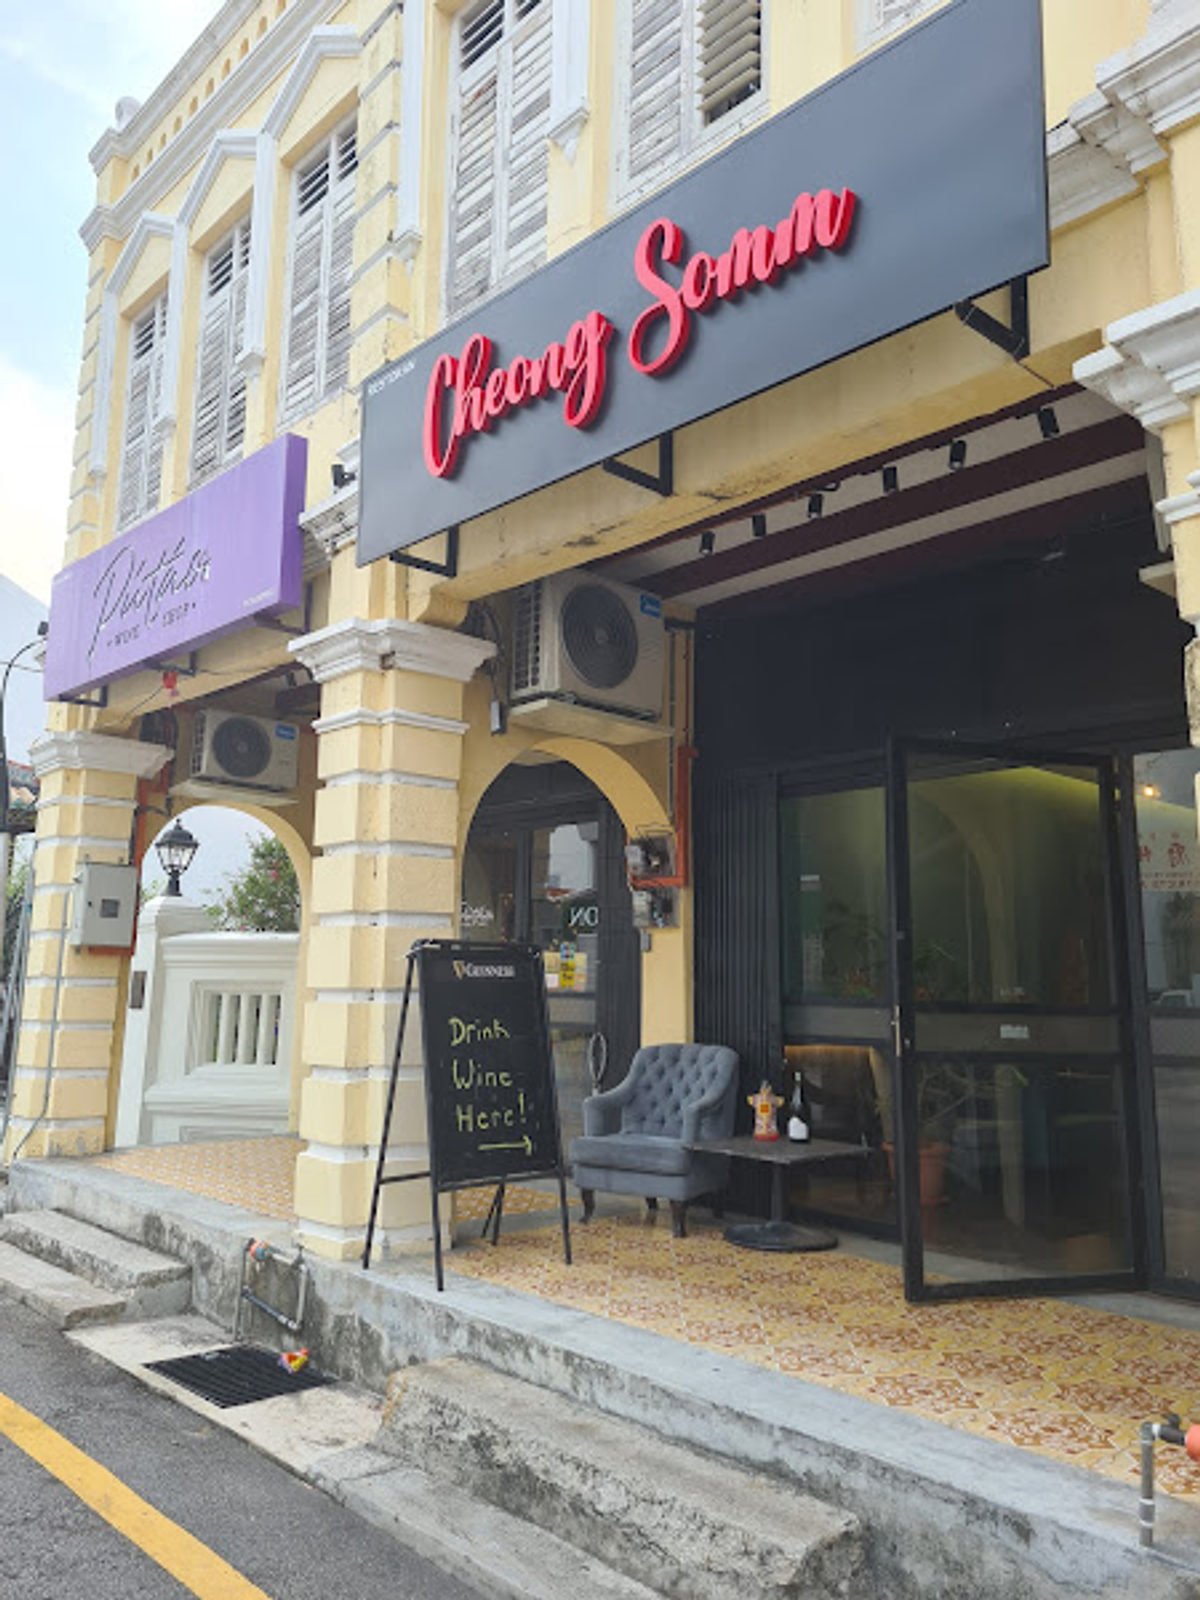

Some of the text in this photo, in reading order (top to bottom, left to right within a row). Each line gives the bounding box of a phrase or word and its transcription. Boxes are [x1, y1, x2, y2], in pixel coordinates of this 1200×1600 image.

[423, 187, 857, 479] Cheong Somm
[448, 1016, 510, 1047] Drink
[452, 1058, 513, 1089] Wine
[456, 1092, 526, 1132] Here!
